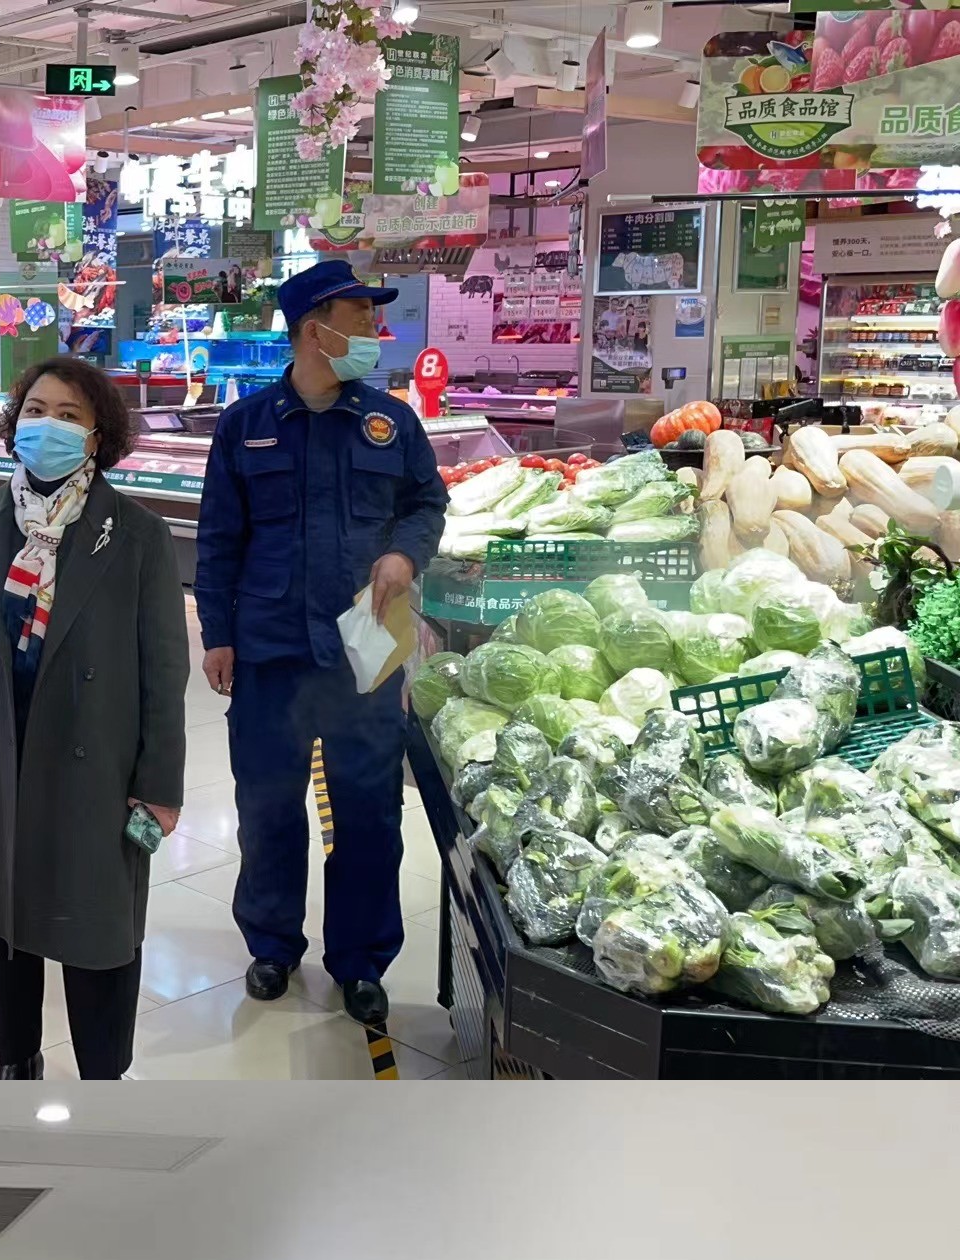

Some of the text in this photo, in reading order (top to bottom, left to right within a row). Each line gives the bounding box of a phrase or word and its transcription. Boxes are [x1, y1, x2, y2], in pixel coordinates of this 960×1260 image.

[738, 96, 841, 119] 品质食品馆
[376, 214, 478, 233] 品质食品示范超市
[421, 354, 438, 377] 8
[444, 592, 528, 609] 创建品质食品示
